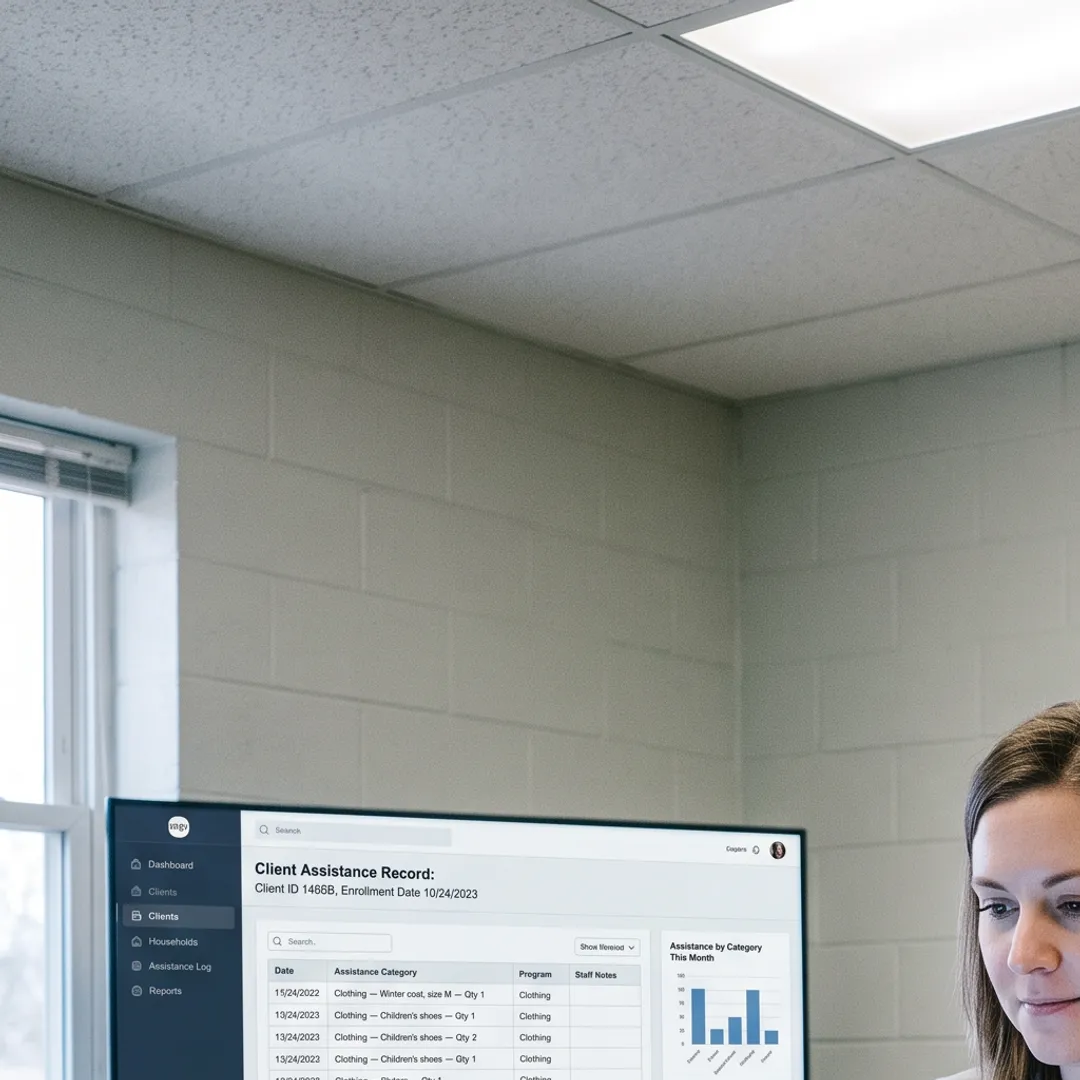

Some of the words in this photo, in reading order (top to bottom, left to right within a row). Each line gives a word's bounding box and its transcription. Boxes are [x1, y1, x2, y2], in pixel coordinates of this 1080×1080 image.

[148, 860, 194, 869] Dashboard
[255, 862, 297, 876] Client
[301, 864, 377, 878] Assistance
[381, 866, 435, 880] Record:
[148, 888, 177, 896] Clients
[255, 883, 284, 893] Client
[288, 884, 299, 894] ID
[341, 886, 394, 896] Enrollment
[398, 887, 420, 897] Date
[424, 888, 478, 899] 10/24/2023
[148, 912, 179, 920] Clients
[148, 938, 198, 946] Households
[670, 942, 713, 950] Assistance
[715, 943, 725, 952] by
[727, 943, 762, 953] Category
[670, 953, 687, 961] This
[149, 962, 194, 971] Assistance
[196, 963, 212, 973] Log
[274, 967, 294, 975] Date
[334, 967, 379, 976] Assistance
[381, 968, 417, 978] Category
[519, 970, 552, 979] Program
[575, 971, 593, 979] Staff
[595, 971, 617, 979] Notes
[149, 986, 182, 996] Reports
[334, 989, 367, 999] Clothing
[380, 990, 405, 998] Winter
[464, 990, 478, 1000] Qty
[519, 991, 551, 1000] Clothing
[334, 1012, 367, 1021] Clothing
[380, 1012, 418, 1020] Children's
[420, 1012, 442, 1020] shoes
[334, 1033, 367, 1042] Clothing
[380, 1033, 418, 1041] Children's
[456, 1033, 470, 1043] Qty
[519, 1033, 551, 1043] Clothing
[335, 1055, 368, 1064] Clothing
[380, 1055, 418, 1063] Children's
[420, 1055, 443, 1063] shoes
[520, 1055, 551, 1064] Clothing
